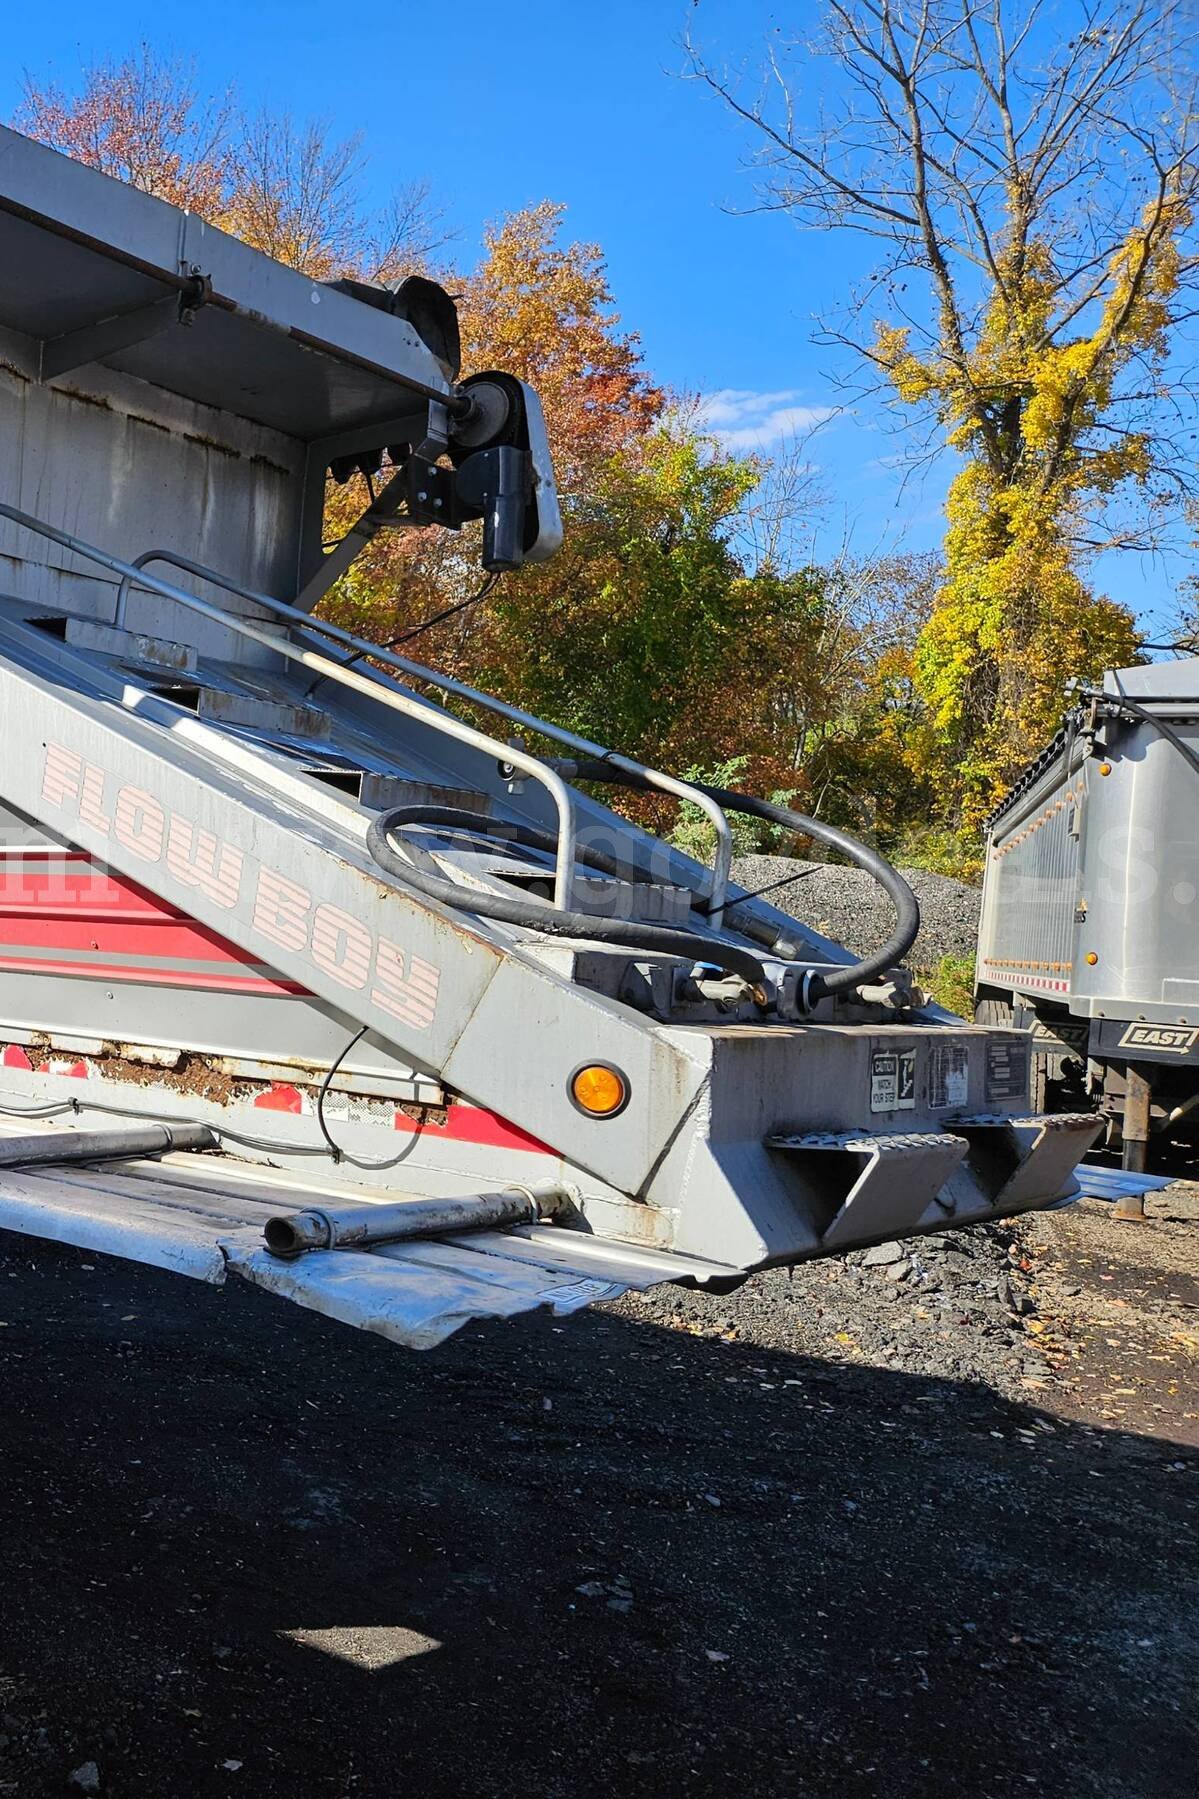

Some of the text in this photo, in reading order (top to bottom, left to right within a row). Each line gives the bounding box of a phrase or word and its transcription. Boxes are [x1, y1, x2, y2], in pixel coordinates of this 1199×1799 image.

[41, 741, 441, 1030] FLOW BOY
[1130, 1029, 1190, 1046] EAST
